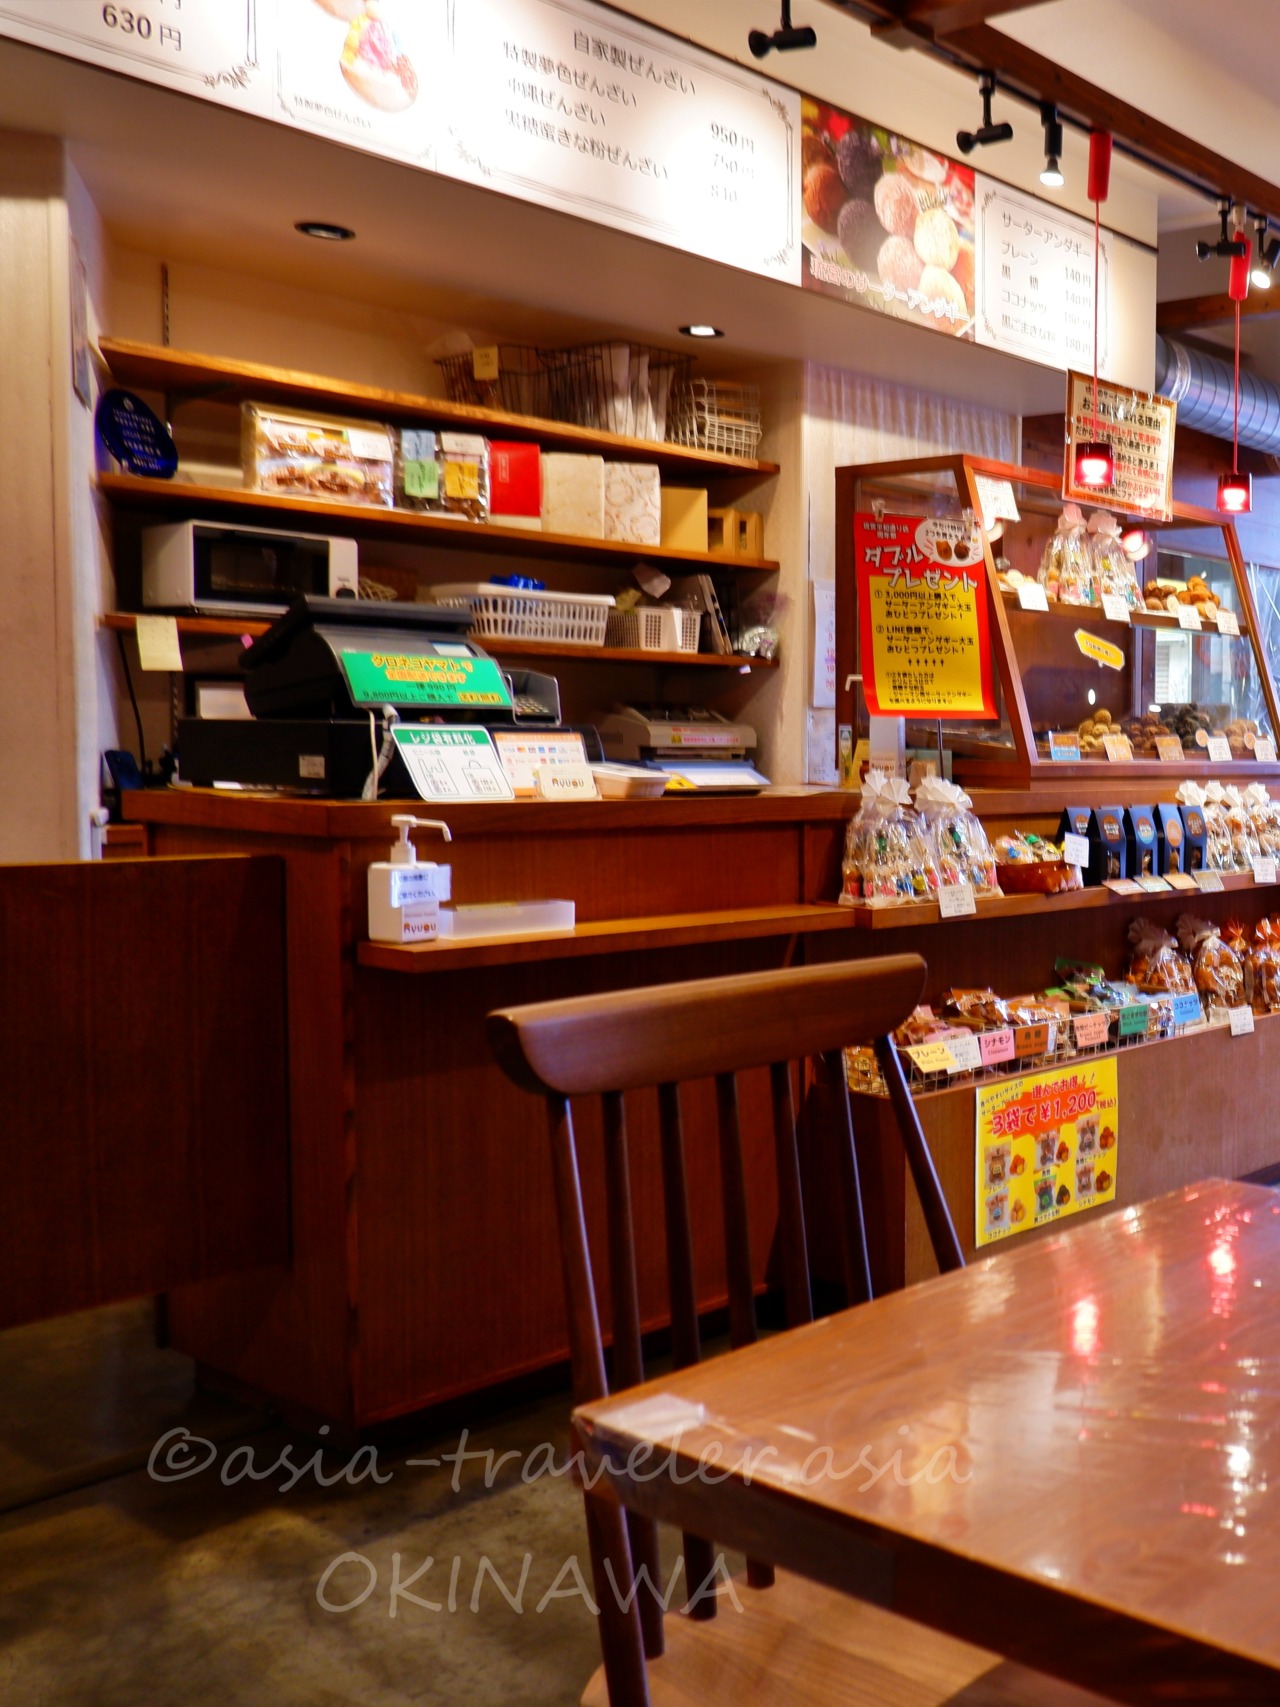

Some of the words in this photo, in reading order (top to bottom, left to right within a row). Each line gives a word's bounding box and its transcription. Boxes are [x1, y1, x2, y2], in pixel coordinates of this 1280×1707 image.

[503, 41, 638, 108] 特製夢色ぜんざい
[574, 28, 696, 96] 自家製ぜんざい
[1002, 210, 1092, 259] サーターアンダギー
[864, 542, 924, 568] ダブル
[882, 566, 979, 593] プレゼント
[372, 653, 474, 673] クロネコヤマトで
[410, 732, 476, 746] レジ袋有料化
[912, 1046, 945, 1059] プレーン
[984, 1035, 1011, 1049] シナモン
